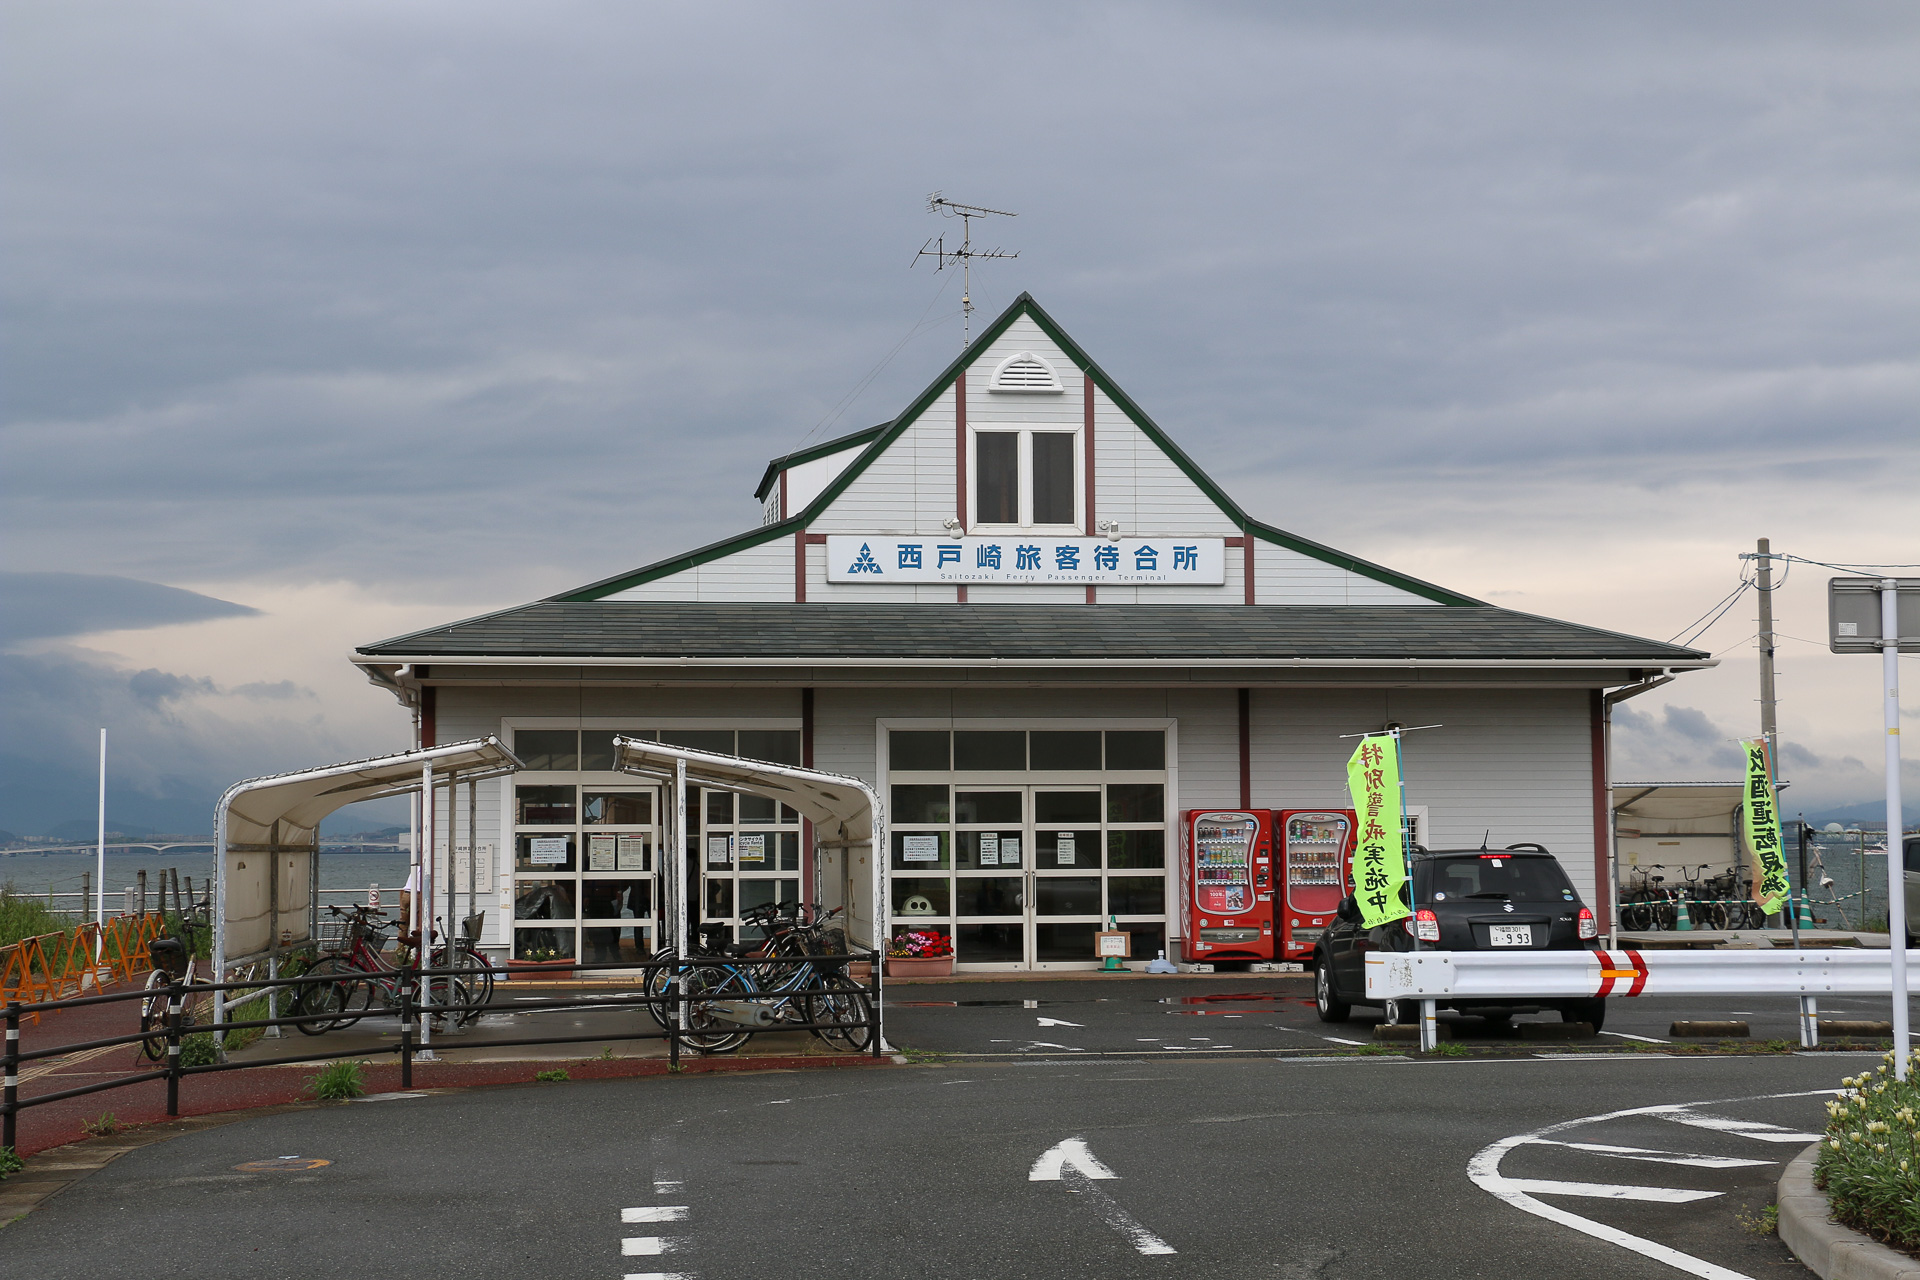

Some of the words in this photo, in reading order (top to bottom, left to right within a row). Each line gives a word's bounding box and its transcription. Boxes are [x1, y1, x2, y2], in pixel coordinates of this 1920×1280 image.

[897, 544, 1198, 571] 西戸崎旅客待合所
[1006, 573, 1035, 581] Ferry
